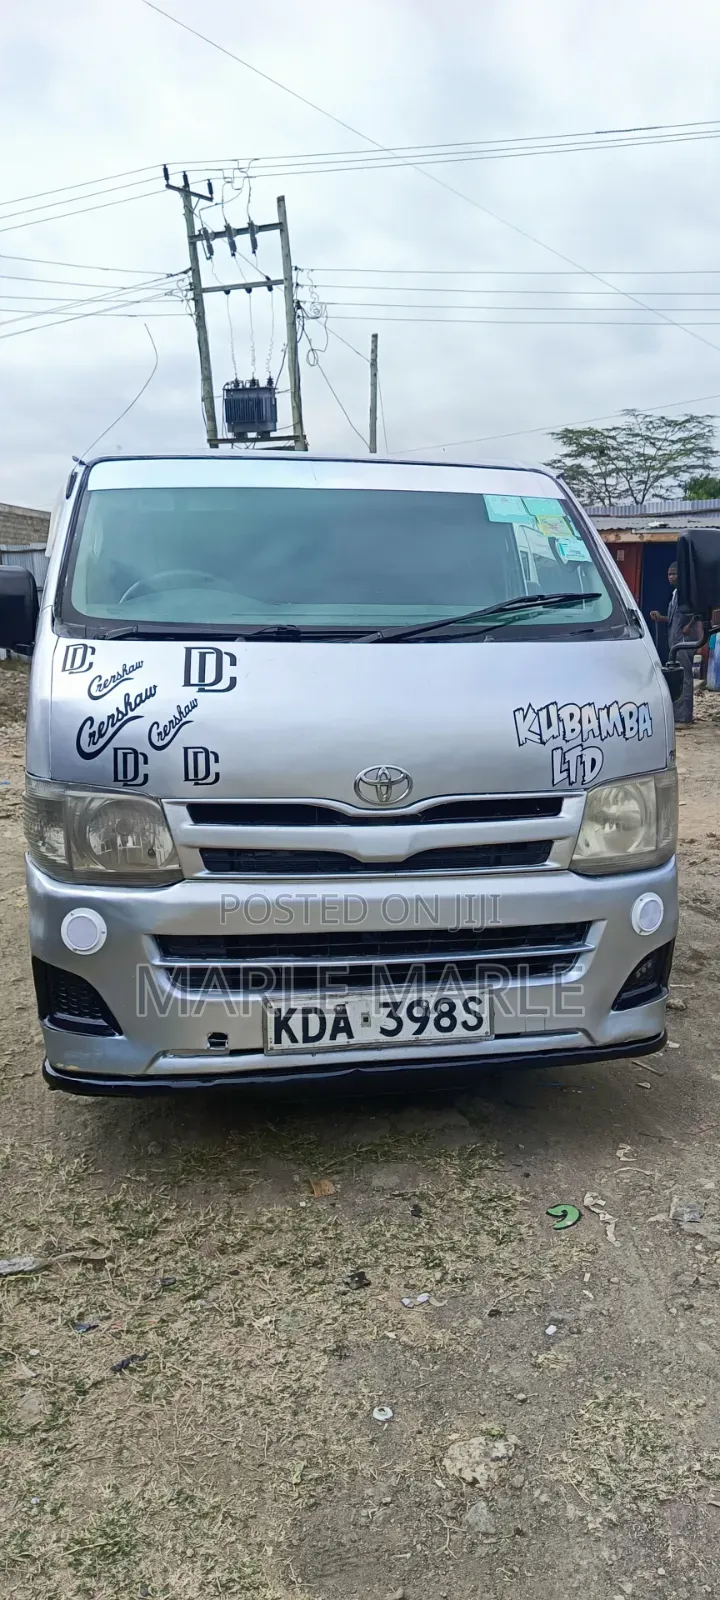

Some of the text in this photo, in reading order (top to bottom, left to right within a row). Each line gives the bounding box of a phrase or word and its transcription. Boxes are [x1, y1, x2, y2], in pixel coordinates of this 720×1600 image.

[513, 700, 653, 747] KUBAMBA
[551, 743, 604, 787] LTD
[273, 996, 484, 1044] KDA 398S
